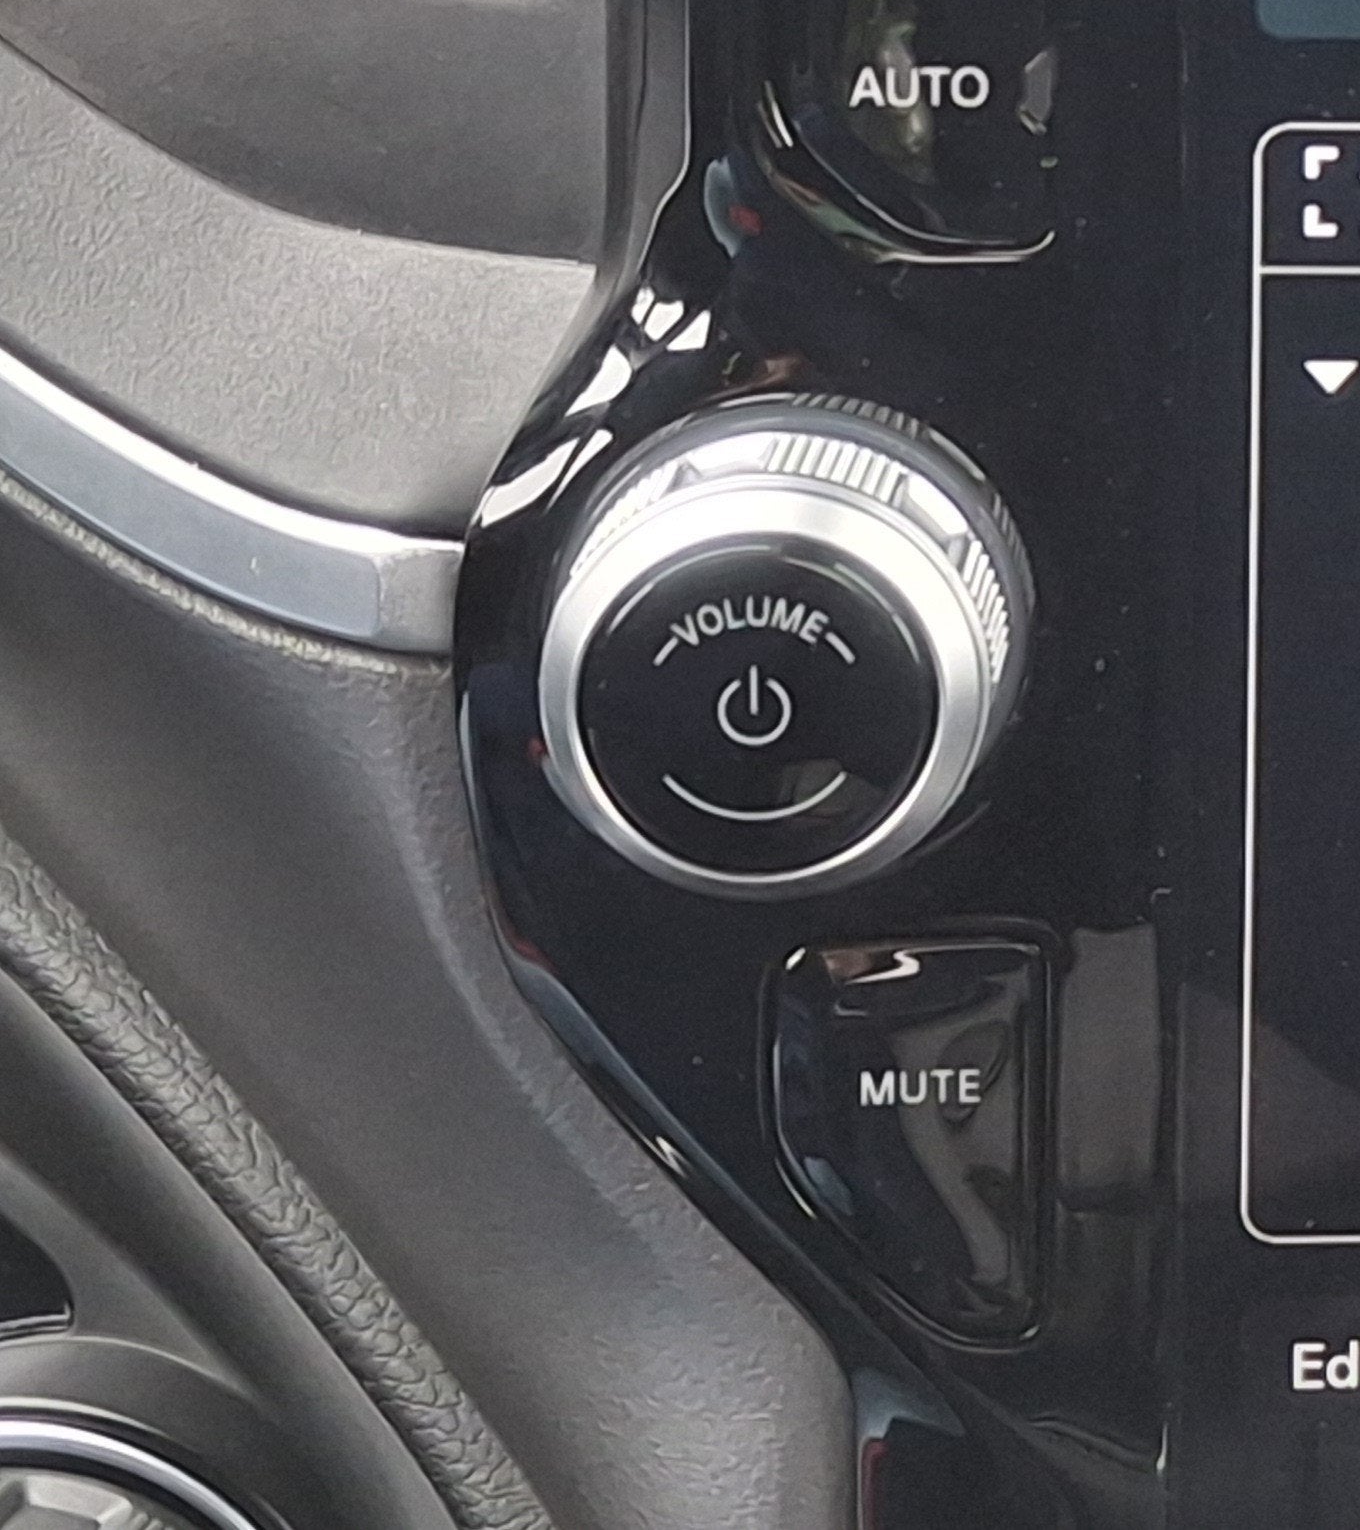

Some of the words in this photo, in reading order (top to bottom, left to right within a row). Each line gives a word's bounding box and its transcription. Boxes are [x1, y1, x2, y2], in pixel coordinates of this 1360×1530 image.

[849, 65, 990, 109] AUTO
[669, 595, 830, 647] VOLUME
[859, 1069, 981, 1107] MUTE
